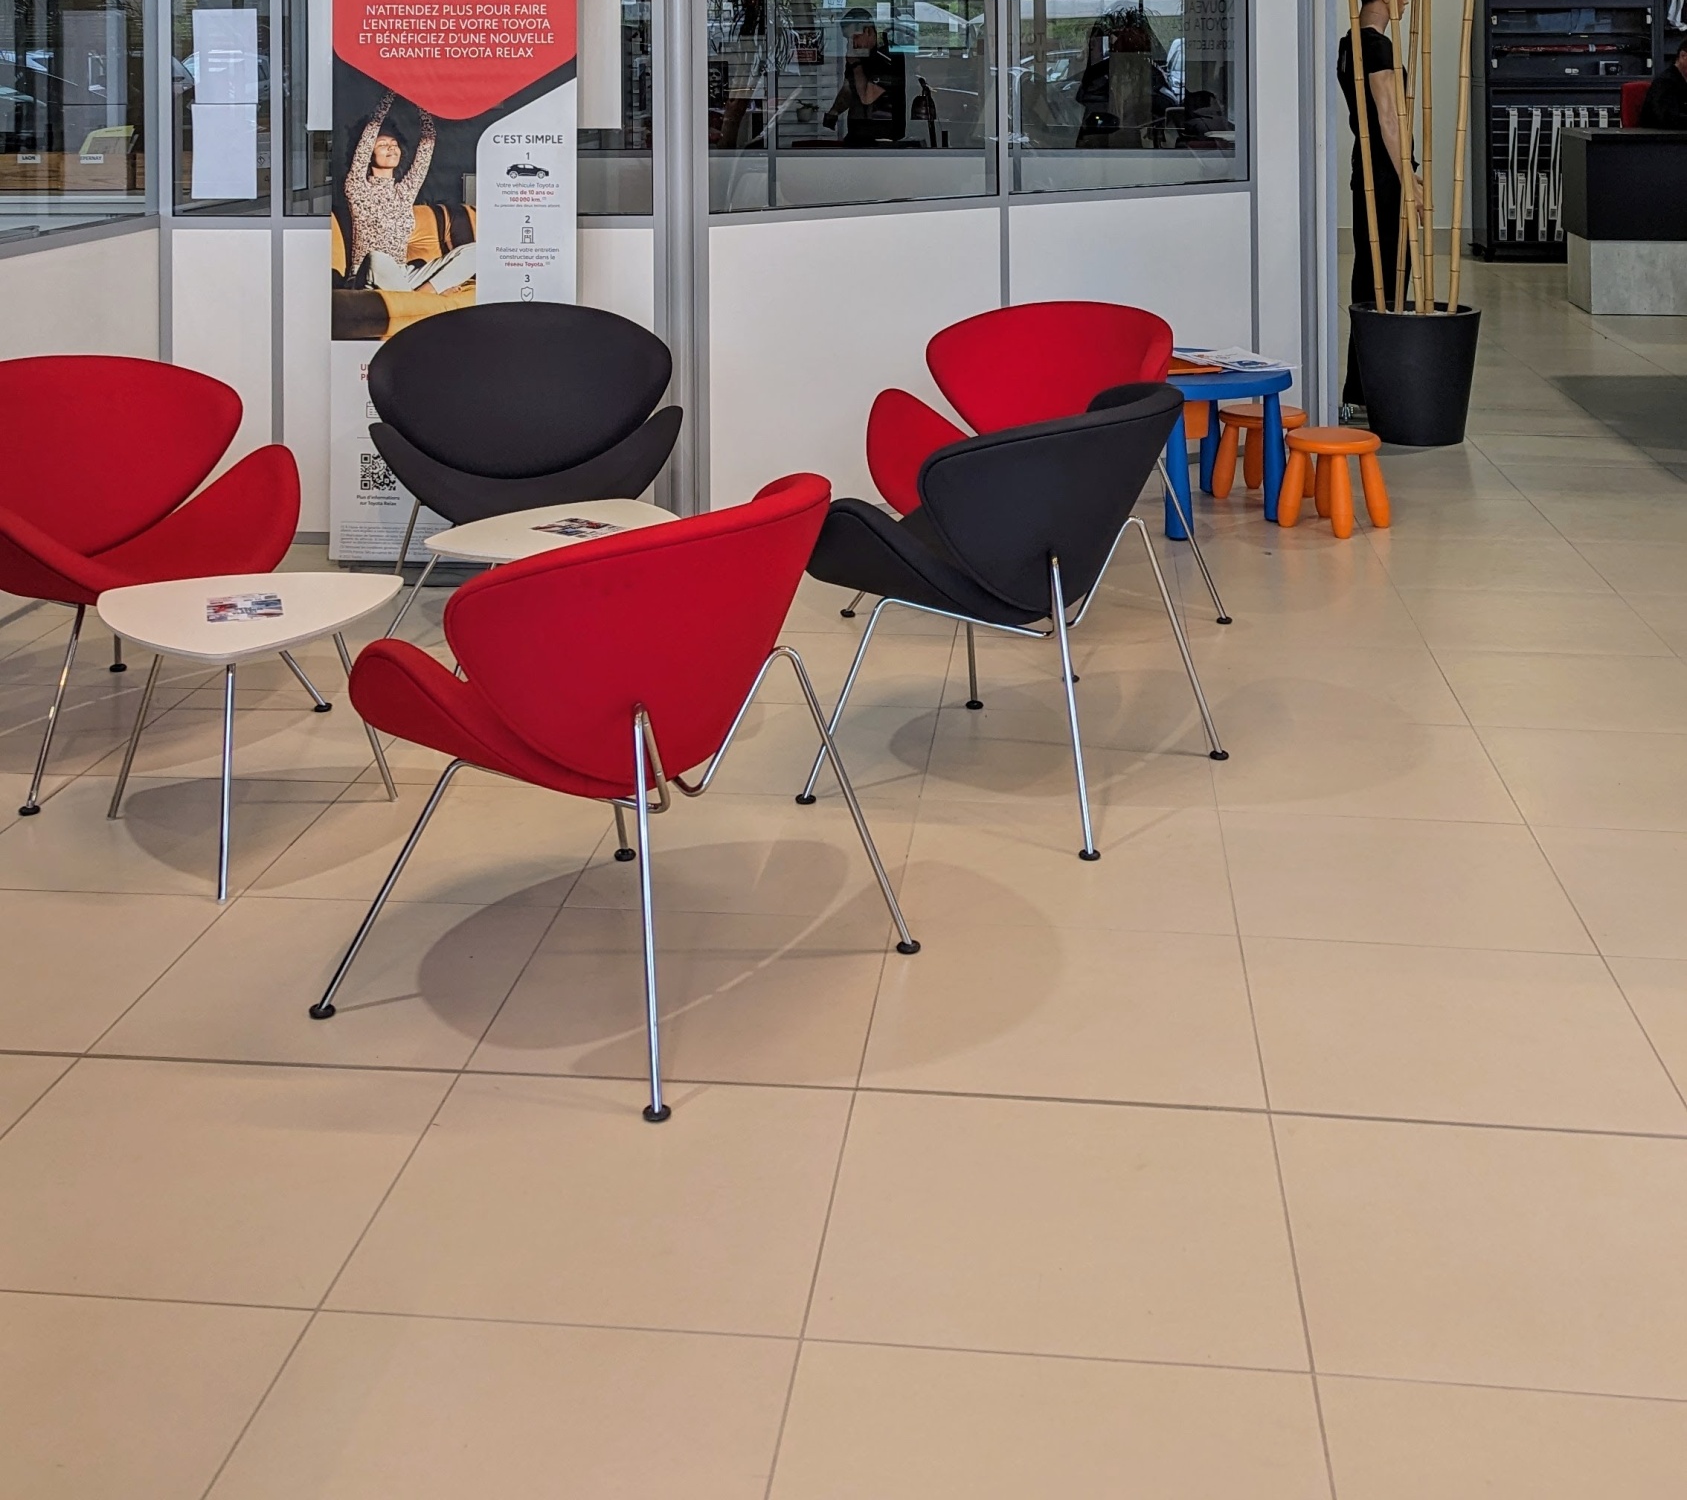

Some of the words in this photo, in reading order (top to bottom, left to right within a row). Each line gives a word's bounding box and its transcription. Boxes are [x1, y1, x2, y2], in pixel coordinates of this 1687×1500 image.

[366, 4, 440, 16] N'ATTENDEZ
[442, 4, 473, 16] PLUS
[476, 4, 512, 16] POUR
[514, 4, 547, 16] FAIRE
[362, 18, 436, 31] L'ENTRETIEN
[440, 18, 456, 31] DE
[459, 18, 499, 31] VOTRE
[502, 18, 551, 31] TOYOTA
[359, 32, 373, 45] ET
[375, 30, 446, 45] BÉNÉFICIEZ
[448, 32, 487, 45] D'UNE
[490, 32, 555, 45] NOUVELLE
[379, 46, 441, 59] GARANTIE
[444, 46, 493, 59] TOYOTA
[496, 46, 534, 59] RELAX
[492, 134, 523, 145] C'EST
[525, 134, 564, 145] SIMPLE
[525, 151, 531, 161] 1
[536, 182, 555, 190] Toyota
[524, 215, 531, 224] 2
[524, 274, 531, 283] 3
